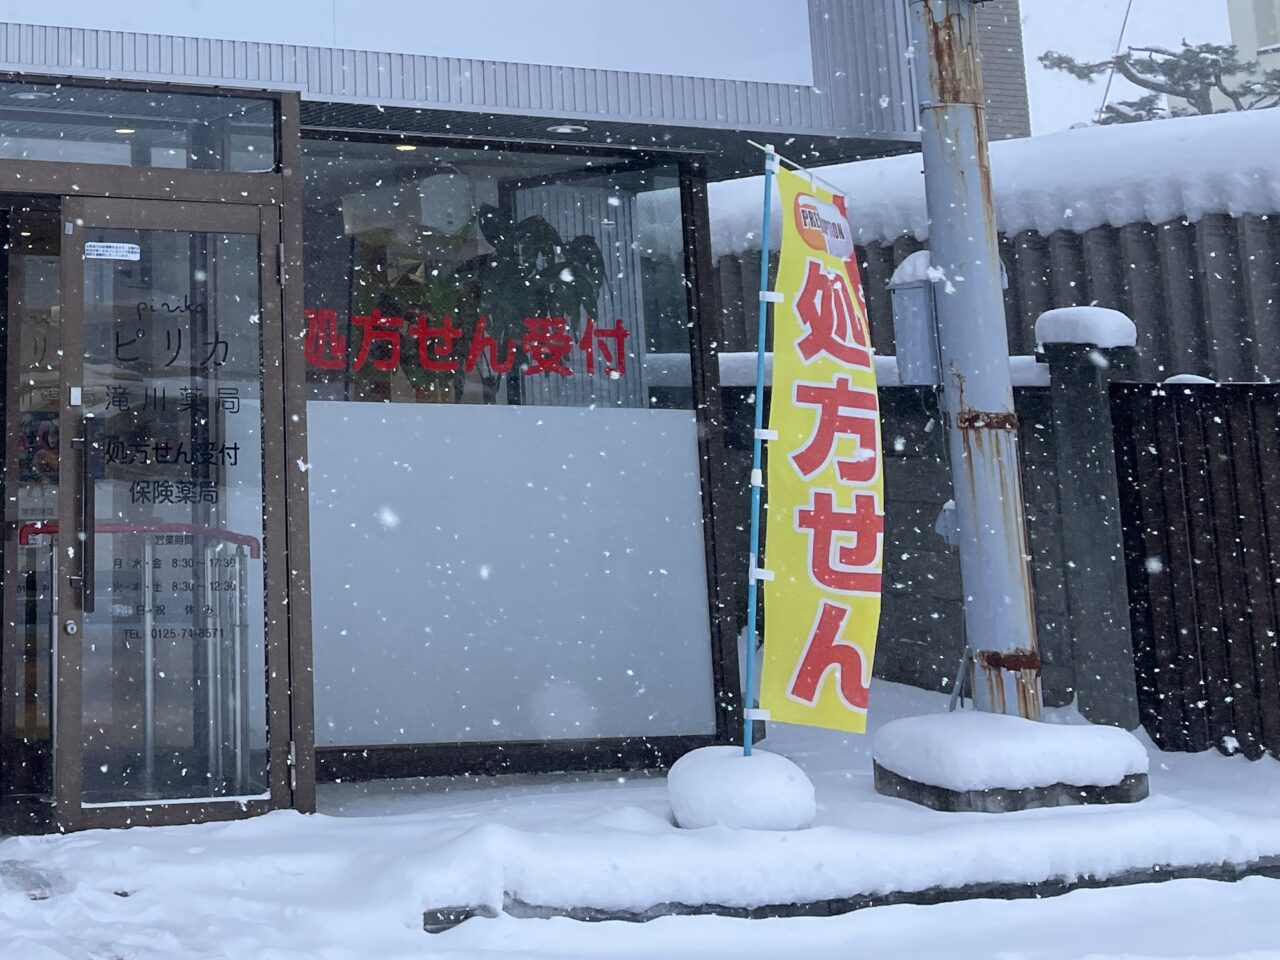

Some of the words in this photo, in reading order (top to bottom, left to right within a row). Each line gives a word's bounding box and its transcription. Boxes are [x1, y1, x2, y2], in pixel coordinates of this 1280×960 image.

[115, 328, 229, 367] ピリカ
[304, 308, 631, 380] 処方せん受付
[104, 385, 241, 414] 滝川薬局
[105, 441, 241, 466] 処方せん受付
[129, 480, 220, 505] 保険薬局
[789, 258, 885, 710] 処方せん
[123, 628, 142, 640] TEL
